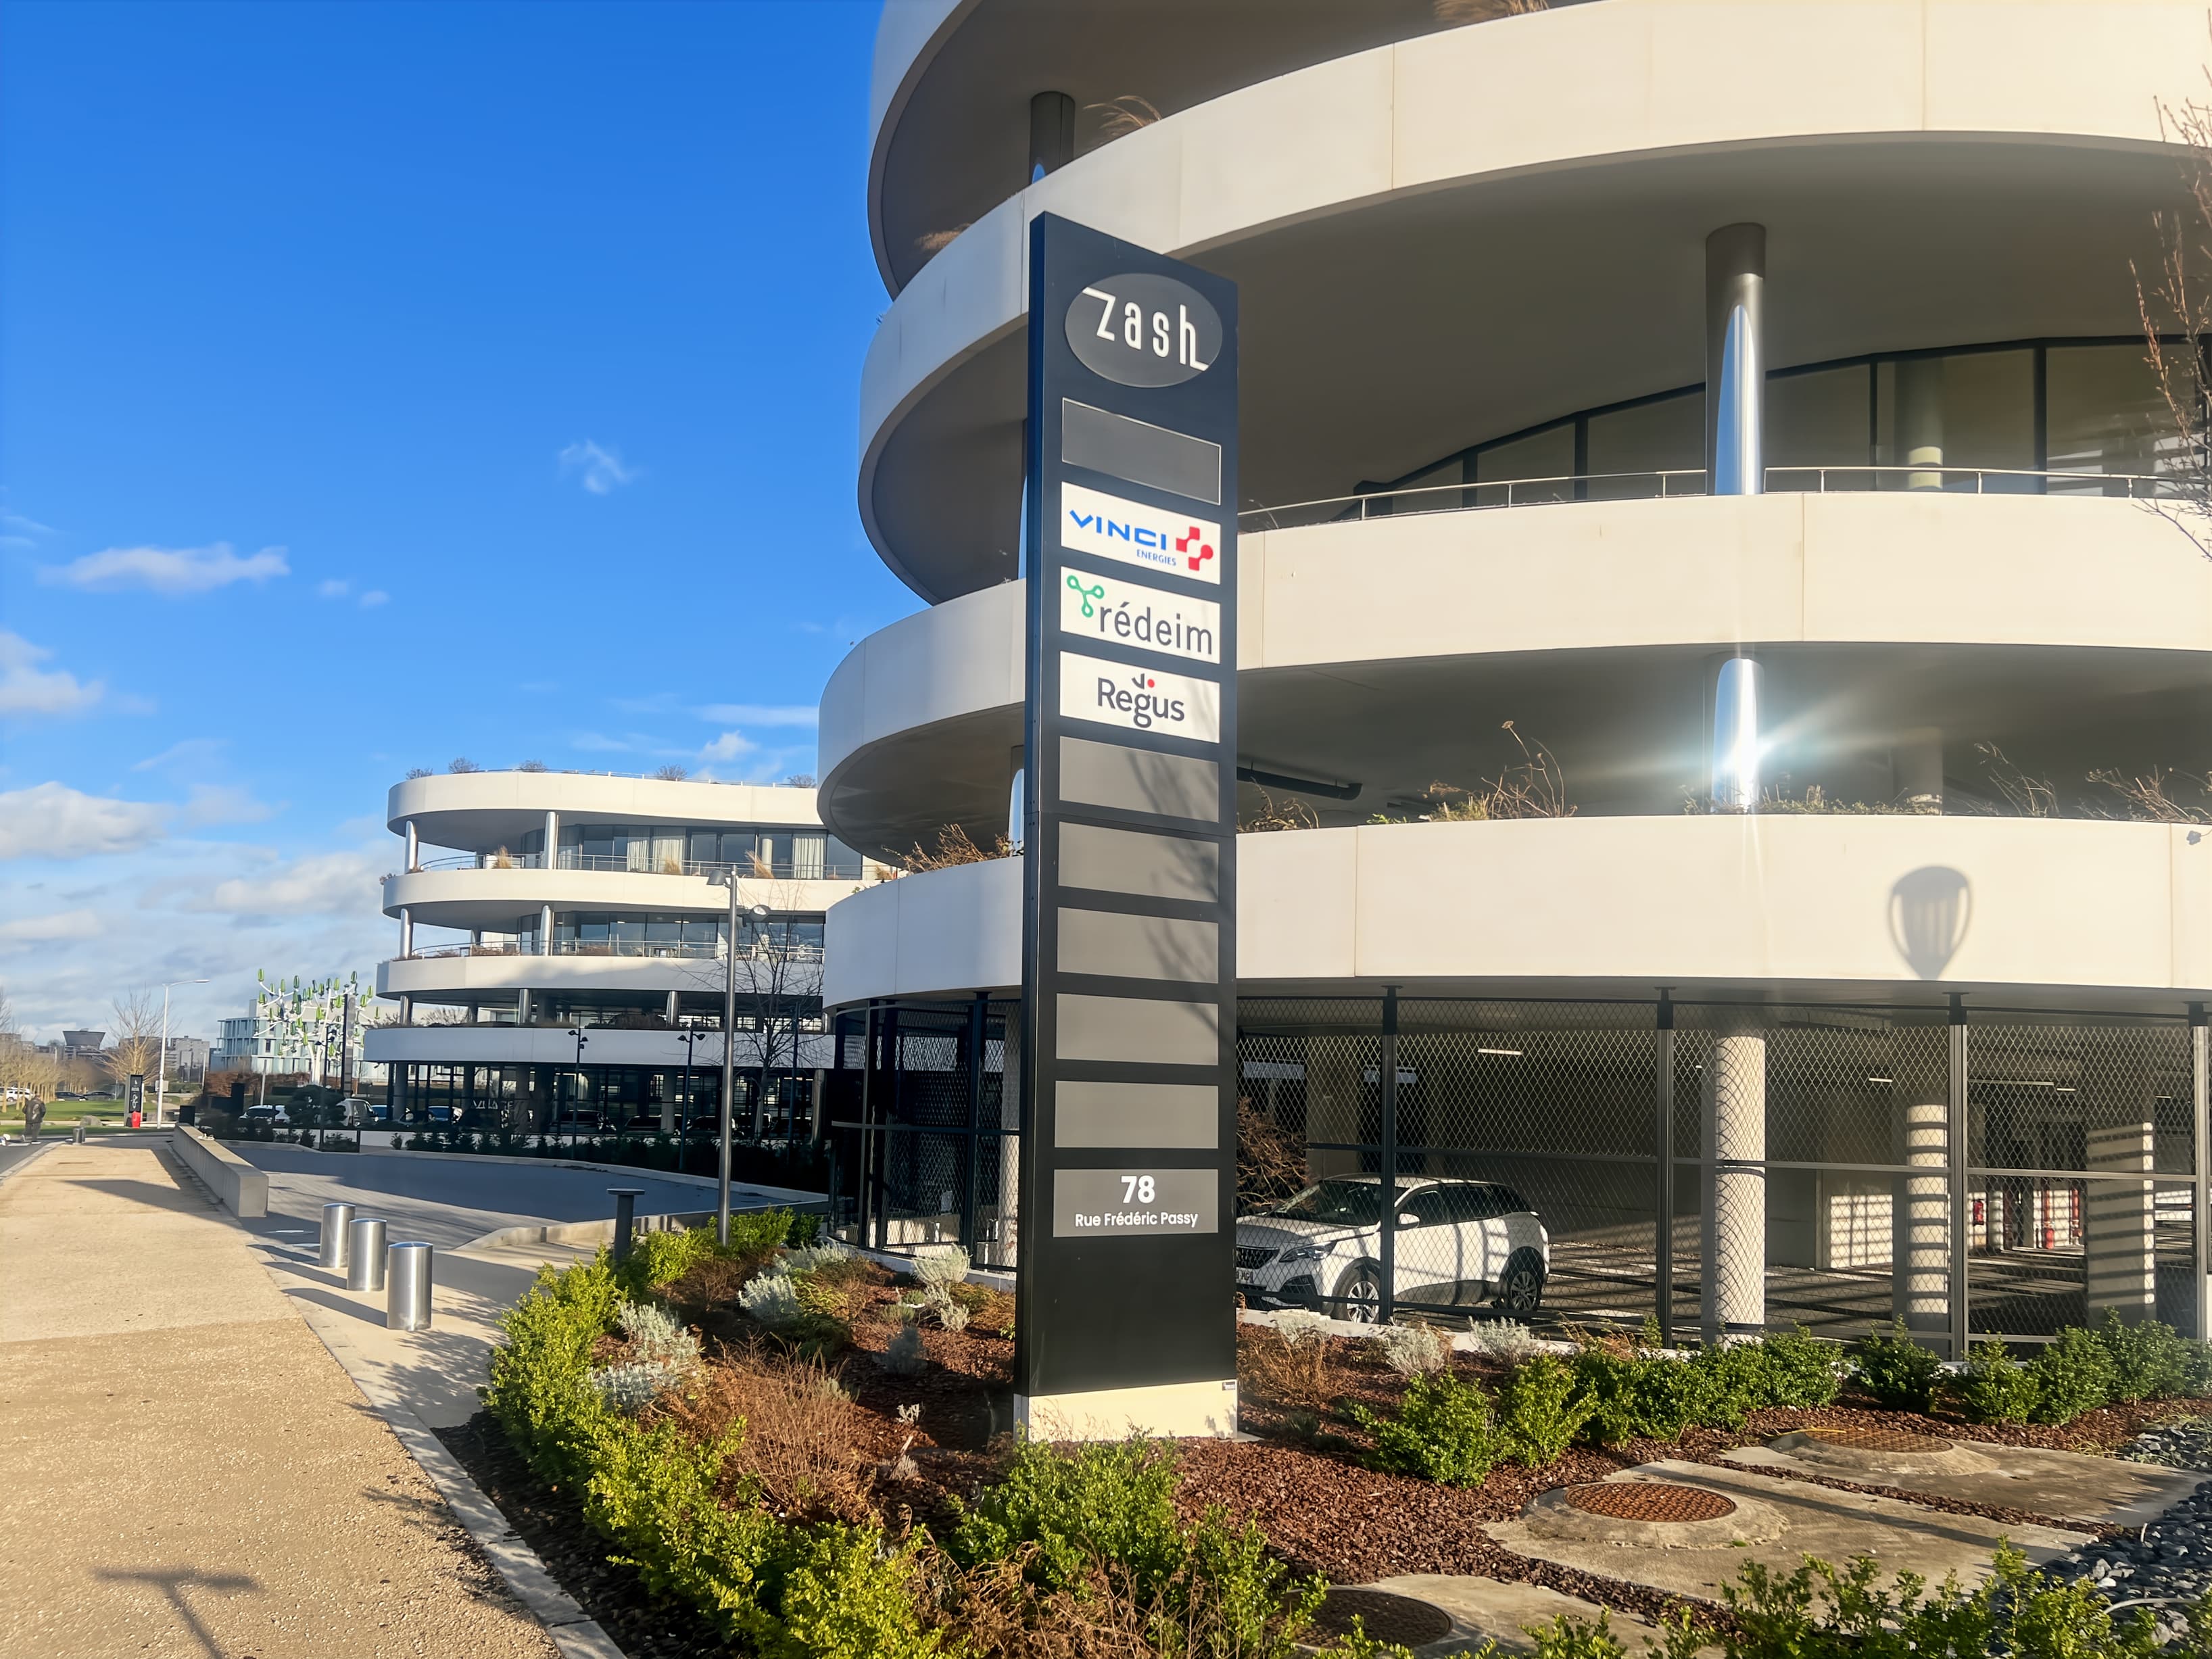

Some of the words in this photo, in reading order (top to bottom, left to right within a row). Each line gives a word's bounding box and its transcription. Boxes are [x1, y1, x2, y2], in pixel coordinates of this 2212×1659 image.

[1069, 510, 1166, 550] VINCI
[1136, 549, 1176, 566] ENERGIES
[1099, 601, 1212, 655] rédeim
[1097, 677, 1185, 729] Regus
[1121, 1175, 1155, 1203] 78
[1075, 1213, 1101, 1227] Rue
[1104, 1211, 1157, 1226] Frédéric
[1161, 1212, 1198, 1228] Passy
